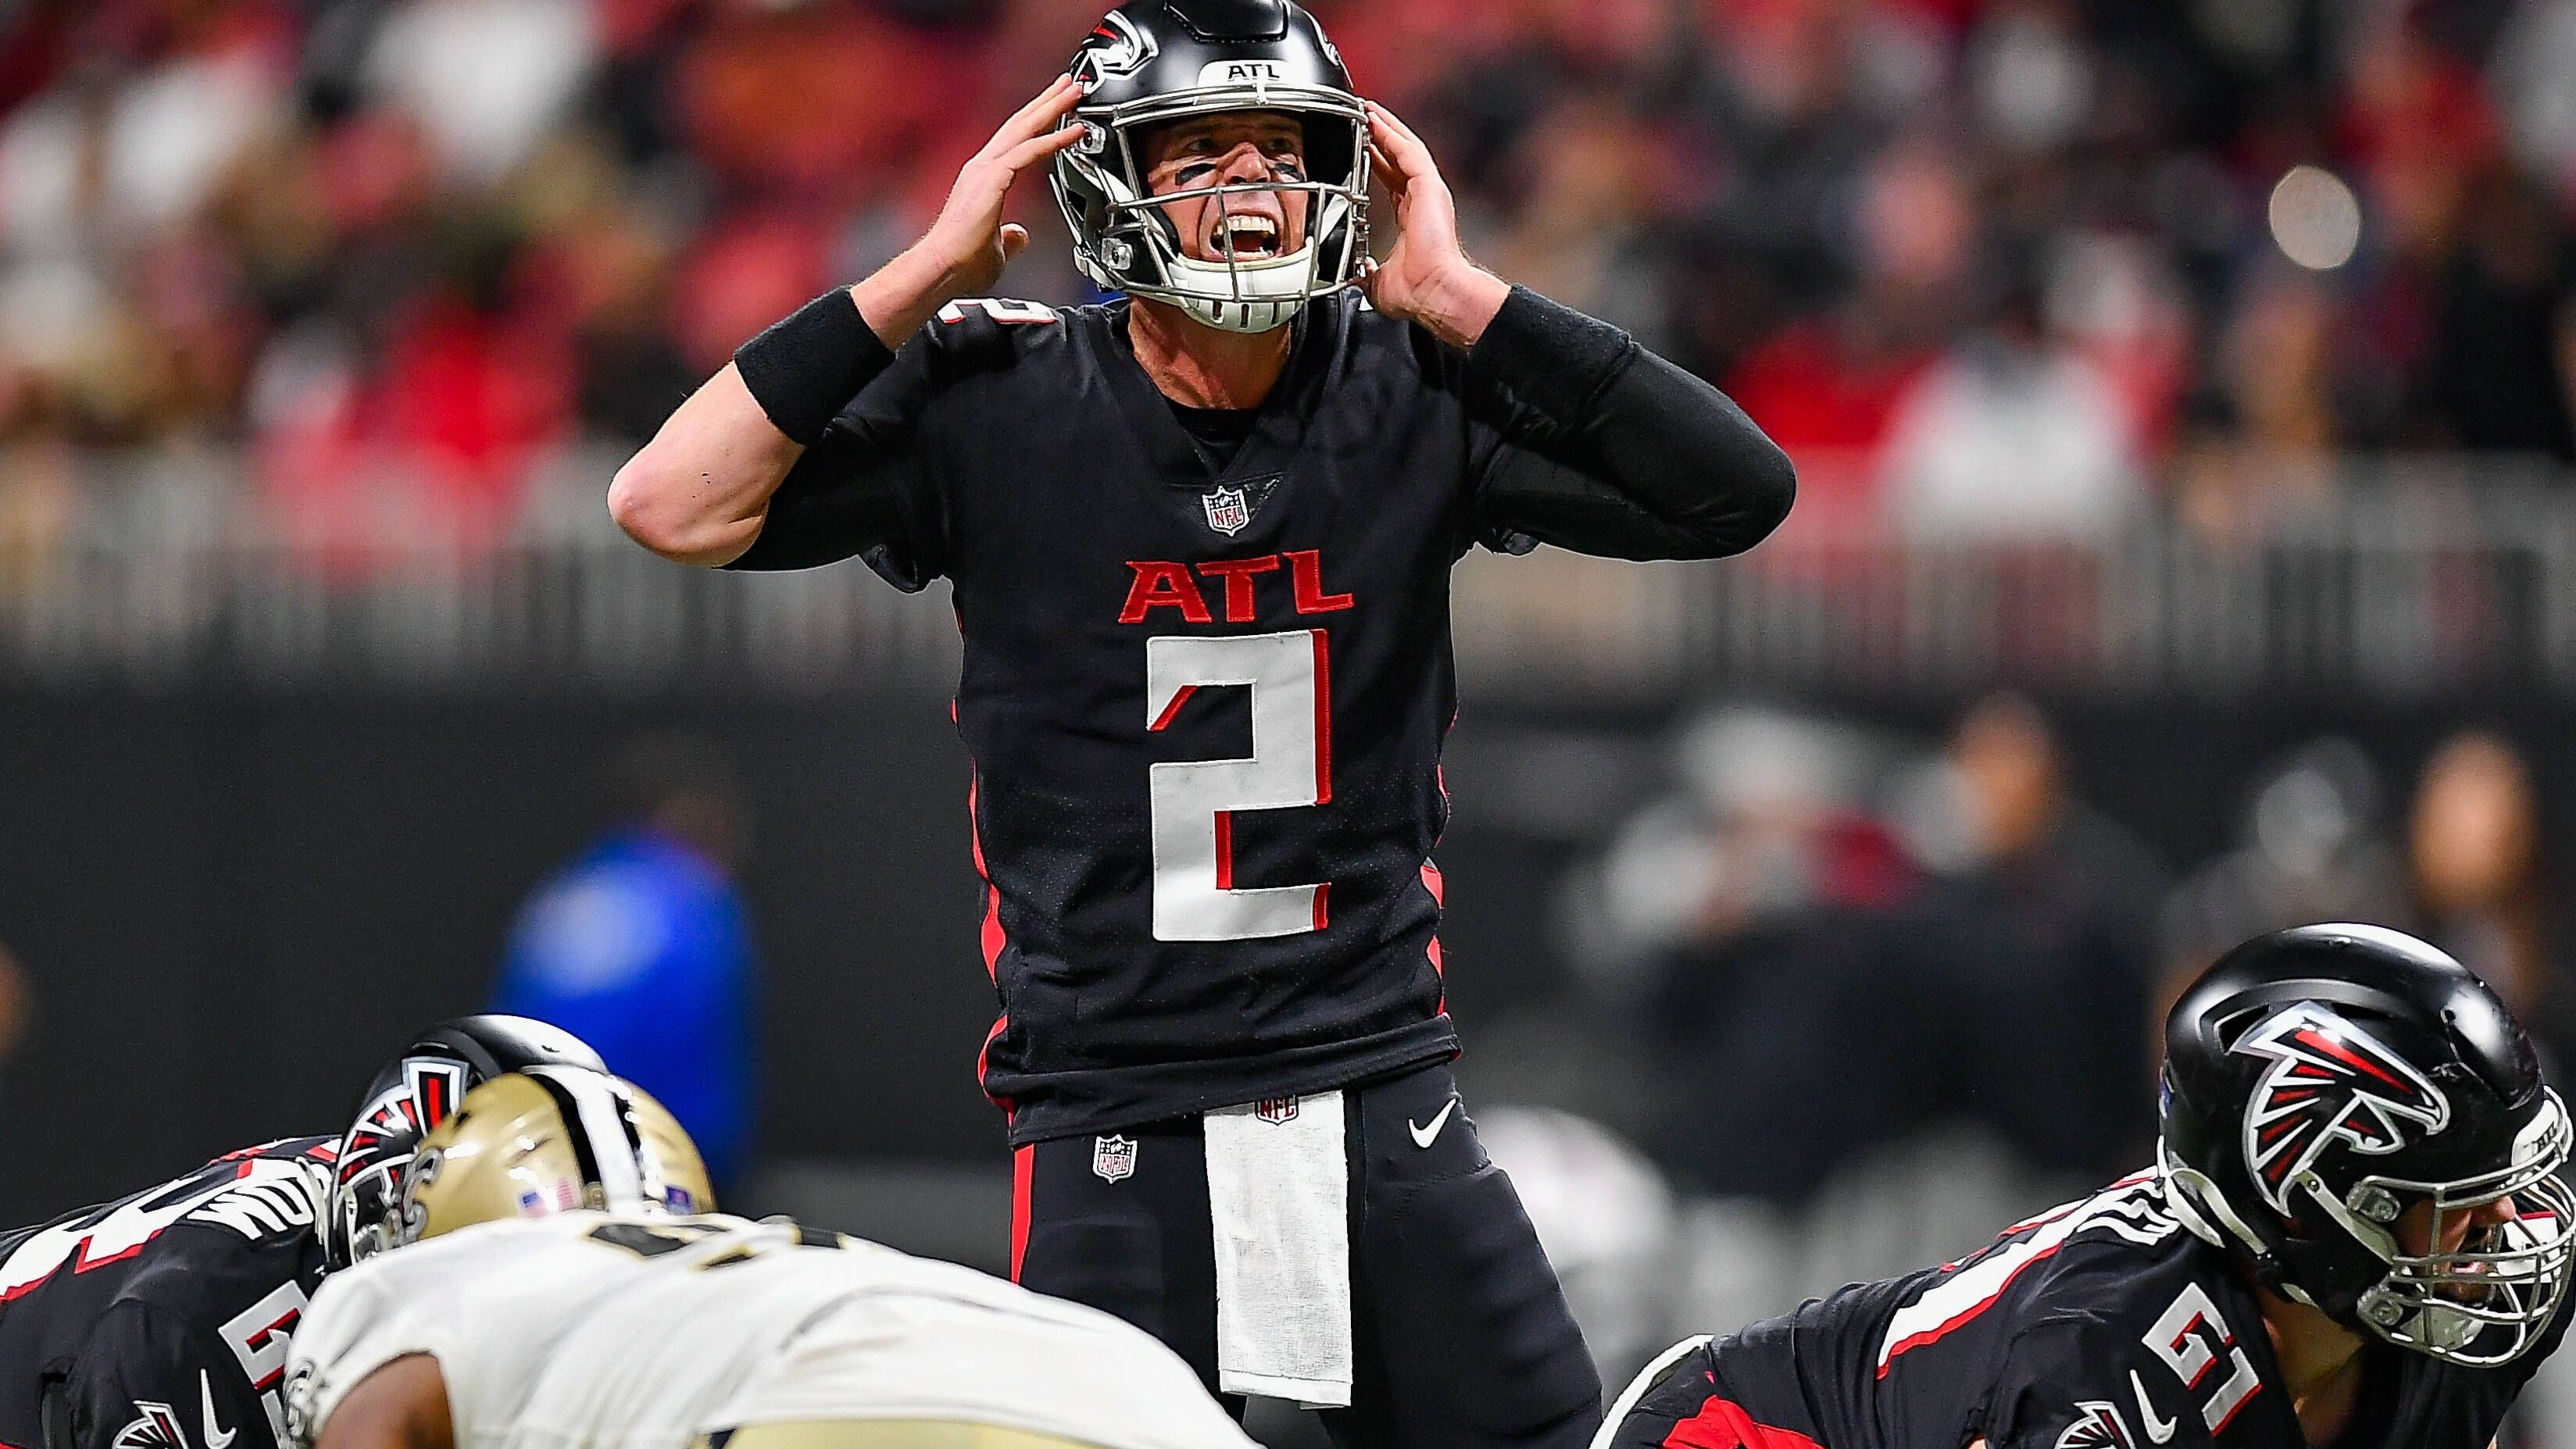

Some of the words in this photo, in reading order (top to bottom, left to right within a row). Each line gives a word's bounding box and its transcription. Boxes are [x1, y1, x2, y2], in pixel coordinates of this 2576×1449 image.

[1227, 64, 1280, 80] ATL
[1213, 507, 1242, 526] NFL
[1118, 549, 1356, 623] ATL
[1146, 628, 1331, 941] 2
[1259, 1097, 1295, 1120] NFL
[1099, 1155, 1128, 1174] NFL
